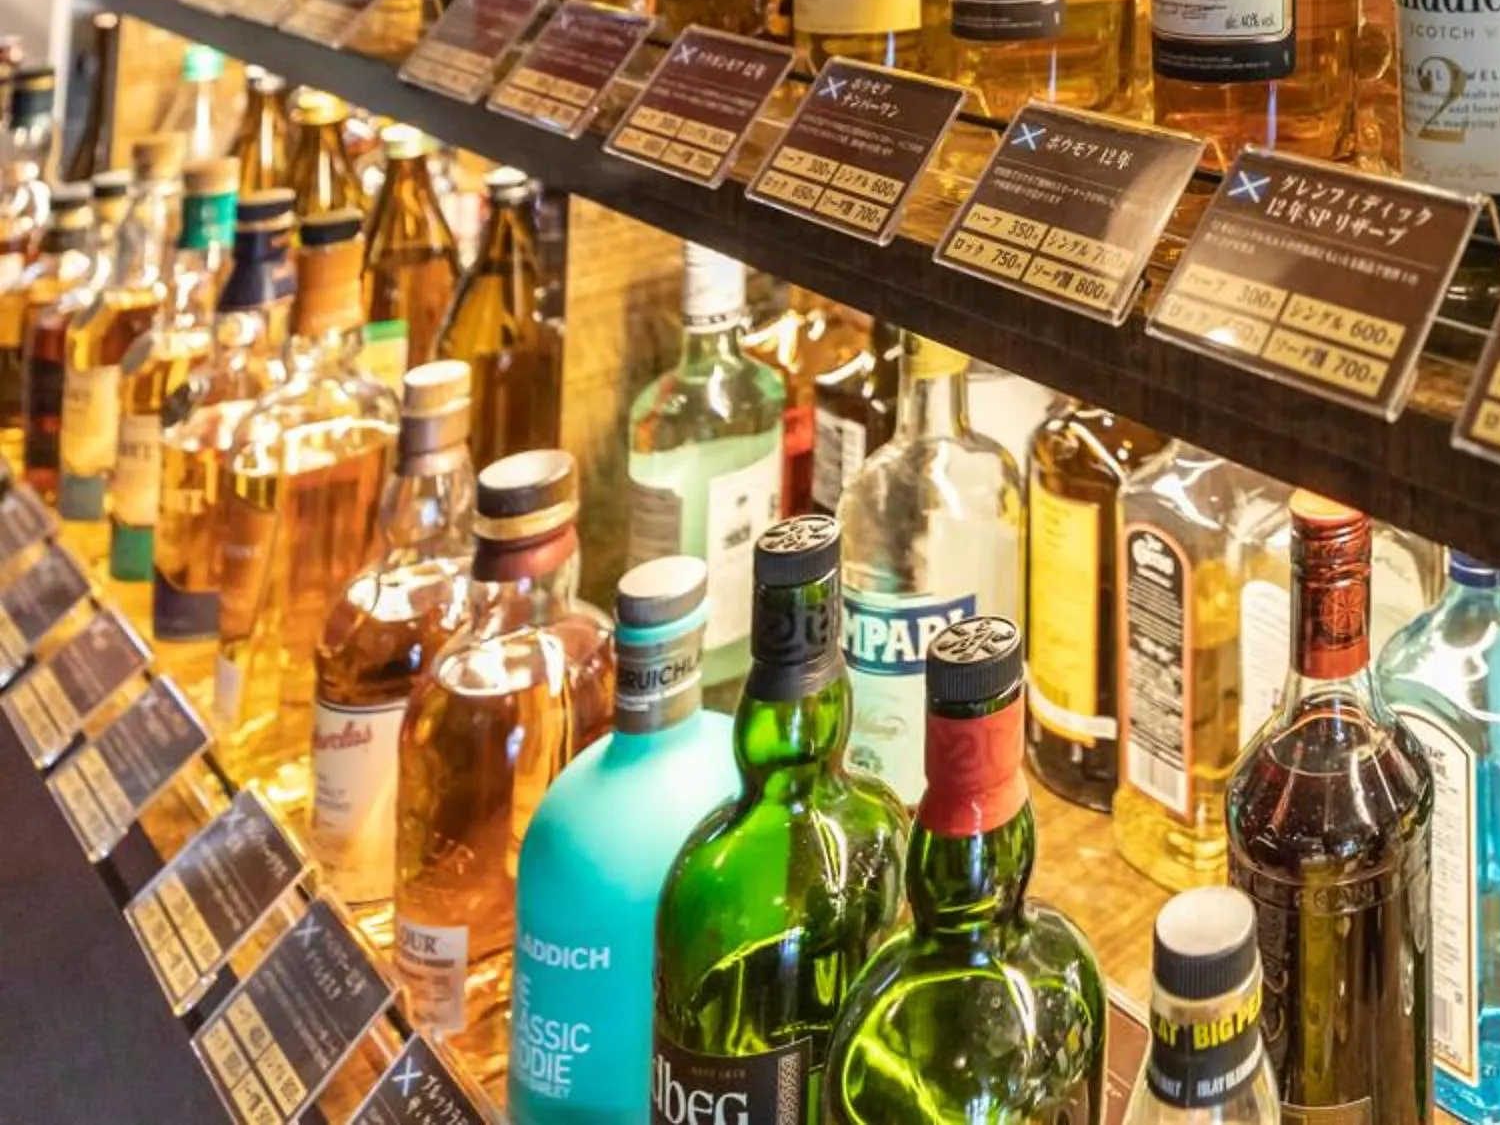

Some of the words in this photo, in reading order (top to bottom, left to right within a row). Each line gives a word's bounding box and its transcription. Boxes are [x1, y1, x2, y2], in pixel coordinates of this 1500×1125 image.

[1280, 175, 1434, 225] グレンフィディック
[521, 934, 610, 970] ADDICH
[516, 1008, 592, 1054] ASSIC
[1194, 1018, 1235, 1051] BIG
